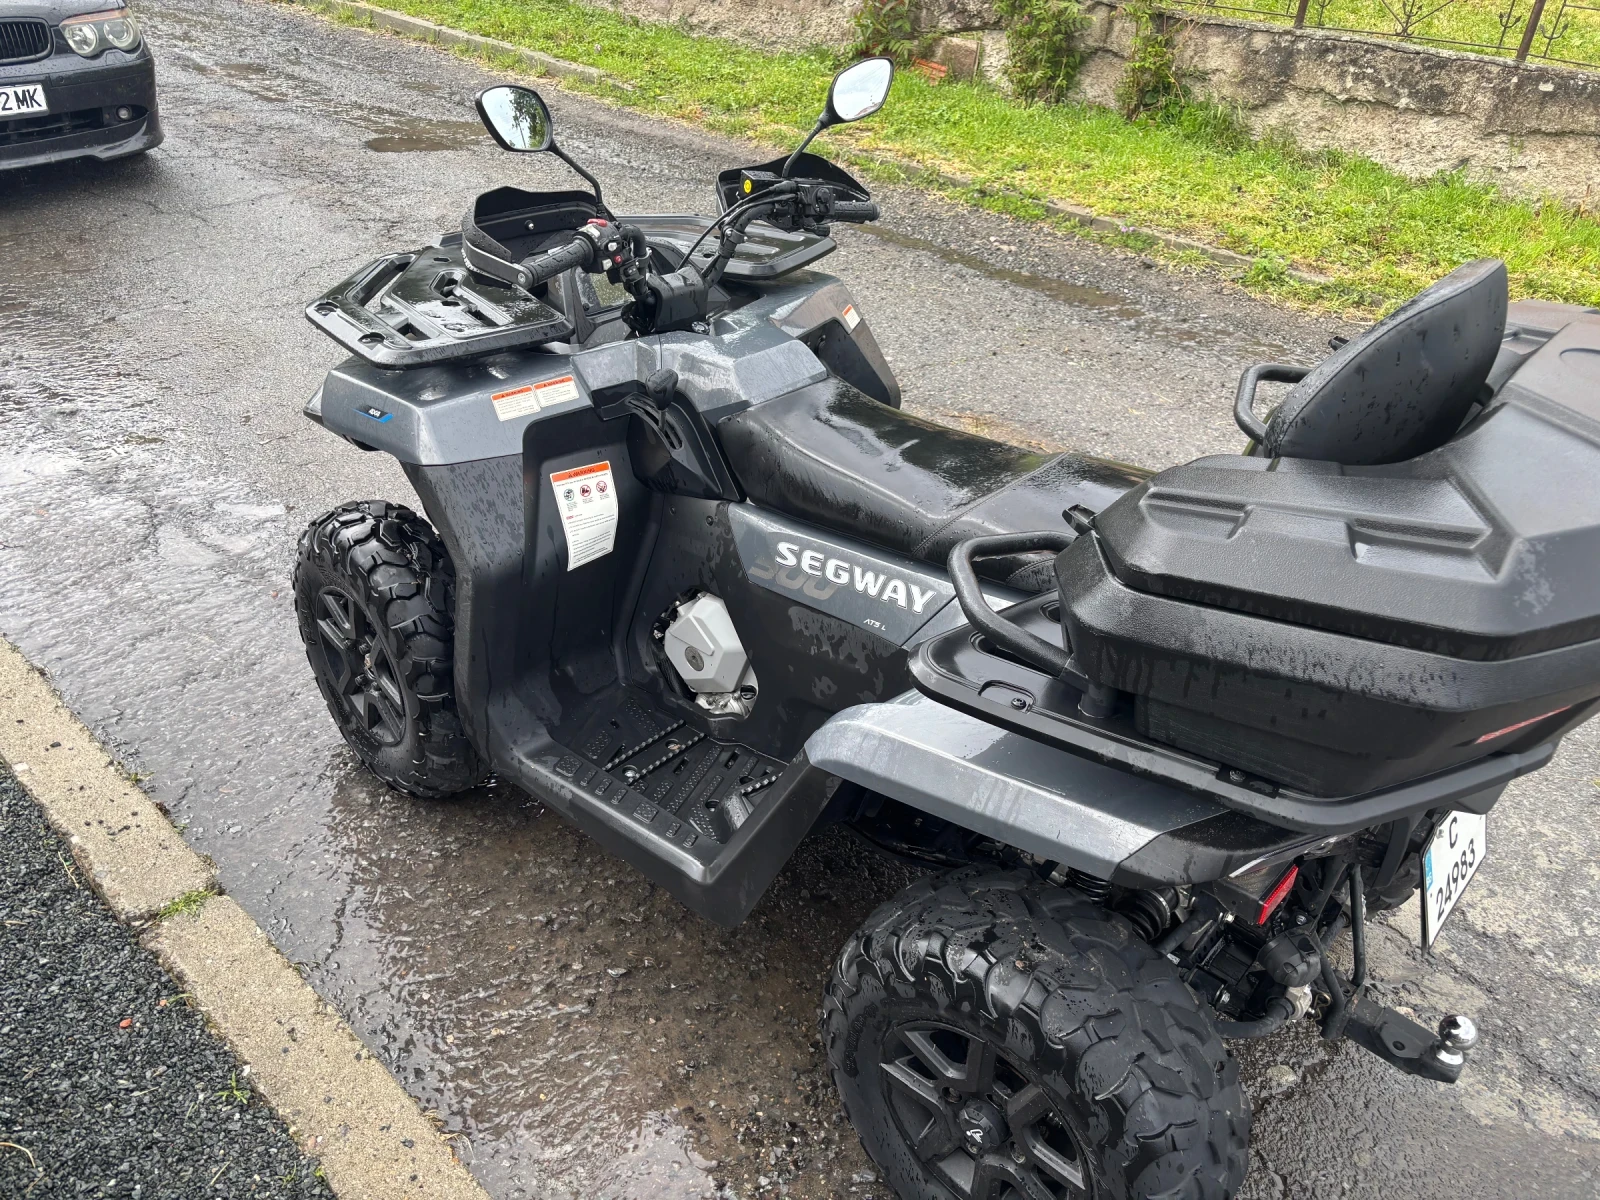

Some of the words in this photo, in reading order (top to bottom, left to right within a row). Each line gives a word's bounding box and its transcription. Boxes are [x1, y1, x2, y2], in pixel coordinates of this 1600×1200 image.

[13, 88, 42, 110] MK
[775, 541, 936, 614] SEGWAY
[1448, 816, 1458, 849] C
[1436, 838, 1475, 922] 24983
